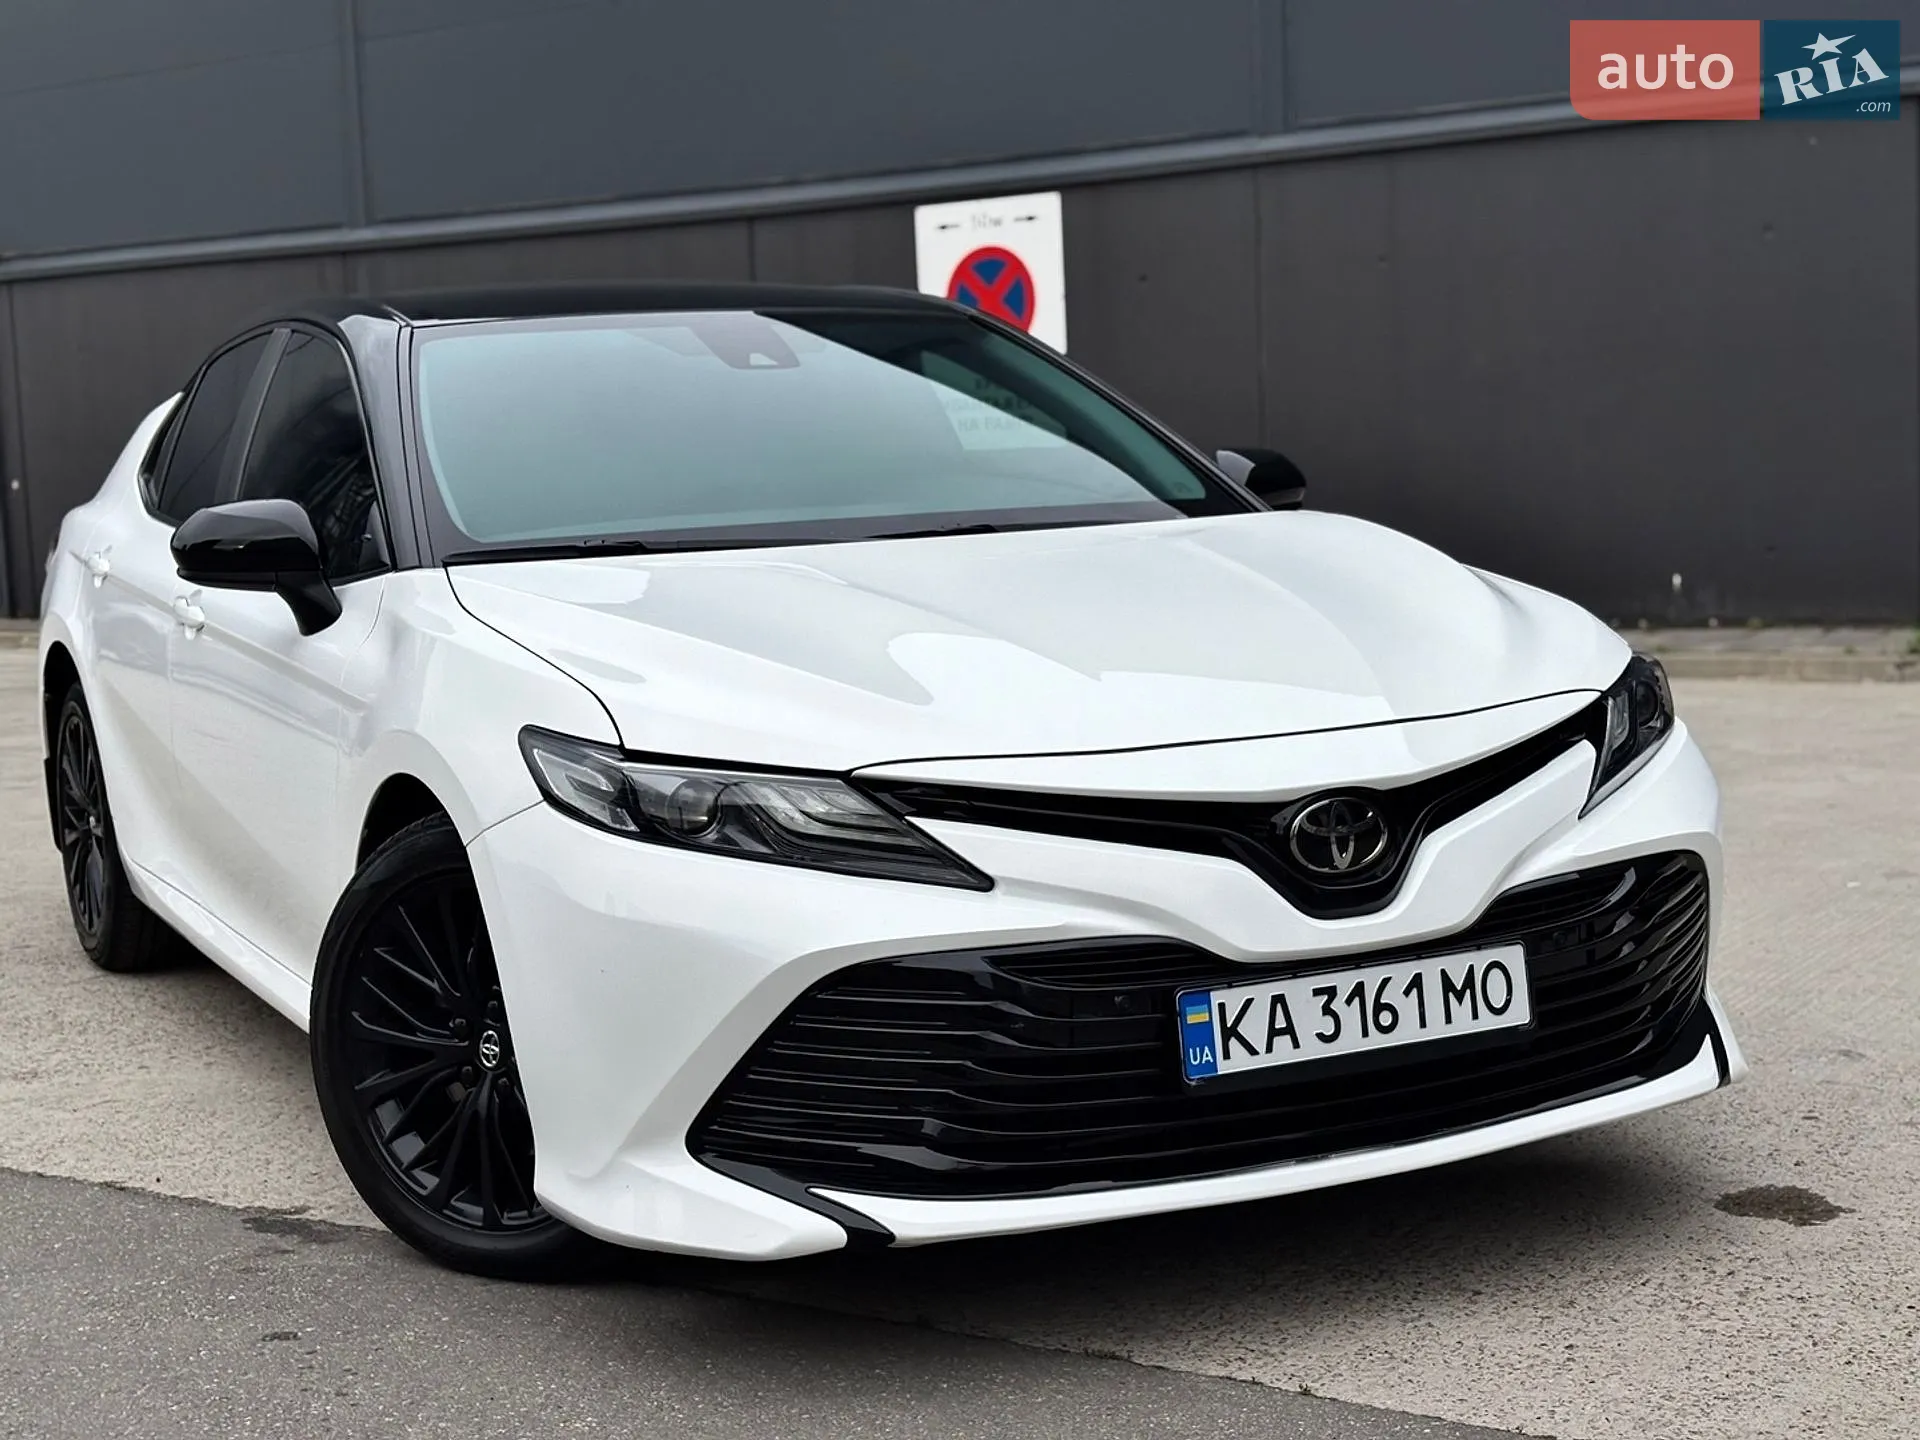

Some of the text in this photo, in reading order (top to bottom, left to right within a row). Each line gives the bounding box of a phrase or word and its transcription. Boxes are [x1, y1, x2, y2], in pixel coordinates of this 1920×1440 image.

[1216, 959, 1514, 1061] KA 3161 MO
[1189, 1045, 1214, 1065] UA
